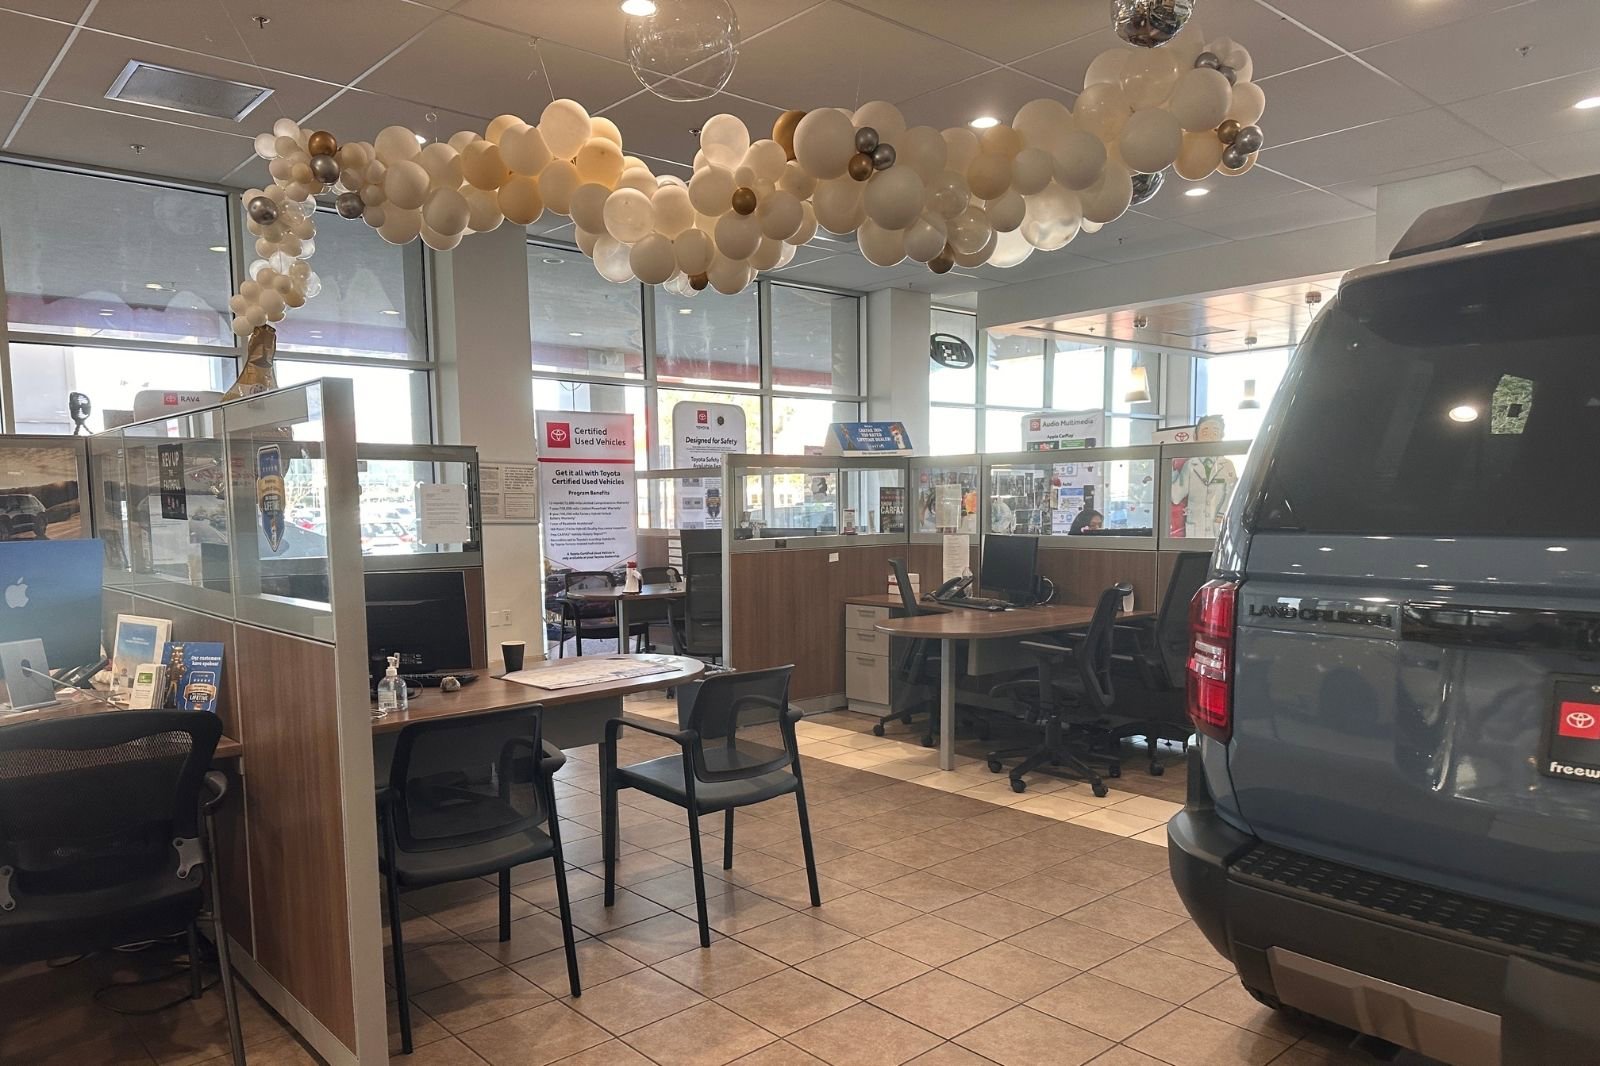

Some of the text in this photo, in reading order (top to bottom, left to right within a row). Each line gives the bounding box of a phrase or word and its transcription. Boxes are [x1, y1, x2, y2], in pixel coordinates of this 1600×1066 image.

[1060, 418, 1094, 426] Multimedia
[574, 428, 608, 436] Certified
[596, 438, 626, 446] Vehicles
[685, 436, 711, 445] Designed
[721, 438, 737, 446] Safety
[881, 506, 904, 514] CARFAX
[1249, 604, 1392, 627] LAND CRUISER
[1550, 761, 1600, 778] freew
